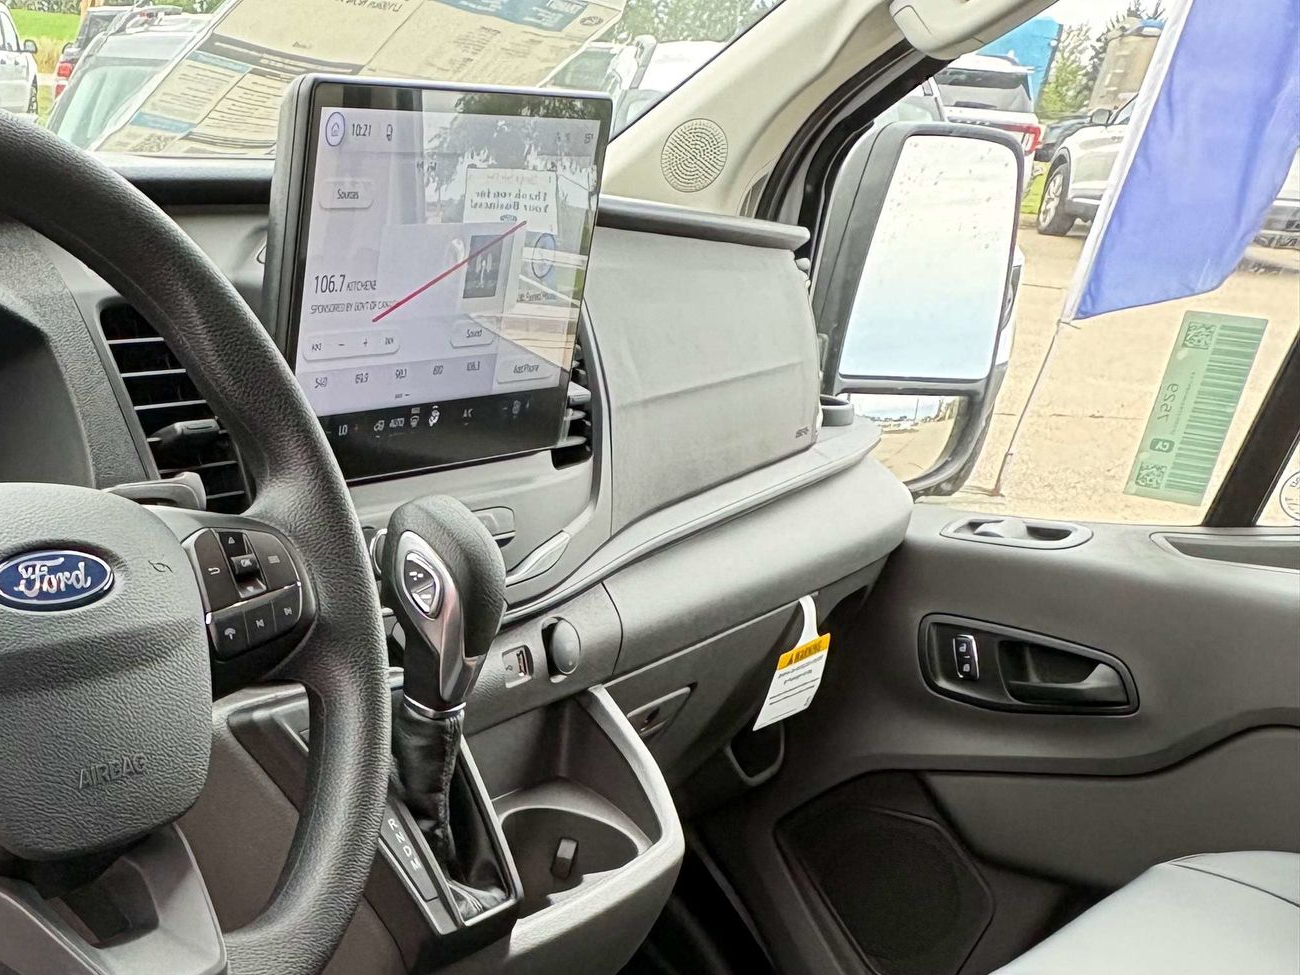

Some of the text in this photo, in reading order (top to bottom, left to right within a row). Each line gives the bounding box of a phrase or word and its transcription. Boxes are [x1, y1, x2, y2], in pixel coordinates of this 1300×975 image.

[351, 122, 372, 137] 10:21
[314, 274, 346, 294] 106.7
[13, 556, 92, 598] Ford
[79, 753, 148, 790] AIRBAG
